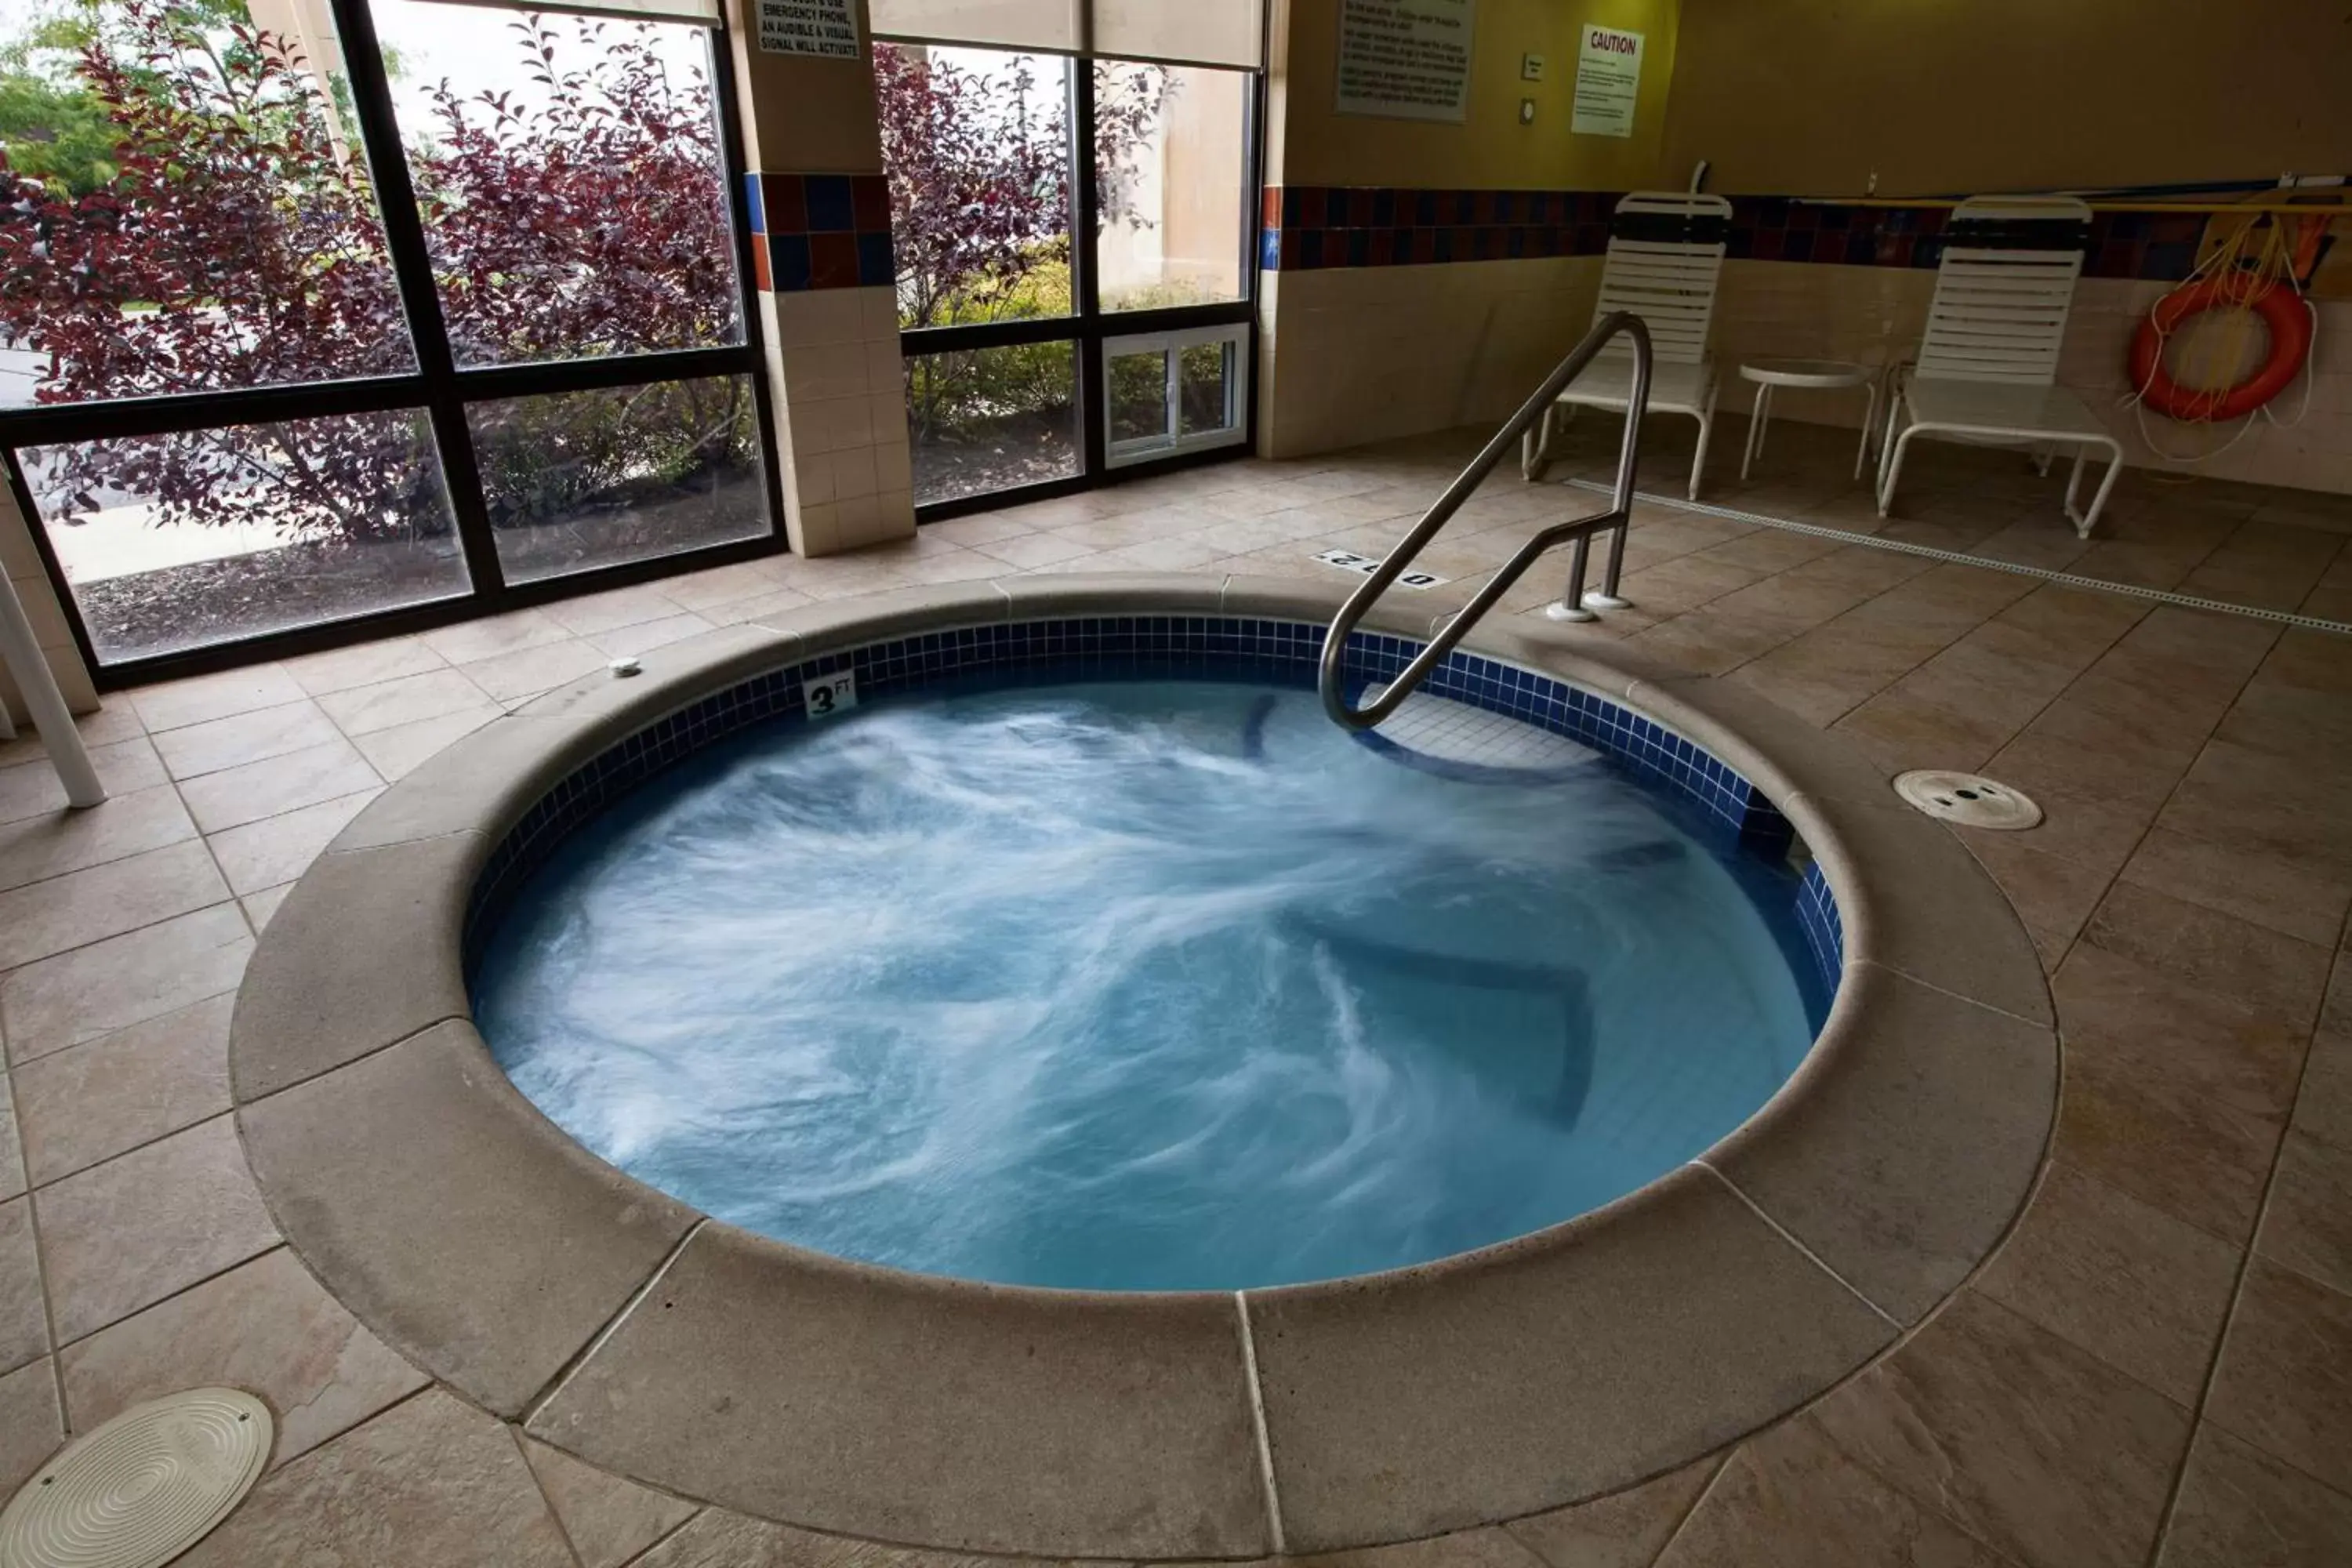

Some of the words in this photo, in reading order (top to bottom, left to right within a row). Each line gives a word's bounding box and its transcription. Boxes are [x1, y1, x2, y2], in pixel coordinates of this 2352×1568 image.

[763, 4, 816, 20] EMERGENCY
[763, 20, 775, 33] AN
[777, 22, 814, 37] AUDIBLE
[816, 24, 822, 38] &
[825, 26, 855, 40] VISUAL
[761, 36, 793, 51] SIGNAL
[796, 39, 817, 53] WILL
[818, 42, 857, 56] ACTIVATE
[1591, 31, 1636, 56] CAUTION
[811, 685, 836, 714] 3
[835, 677, 851, 695] FT
